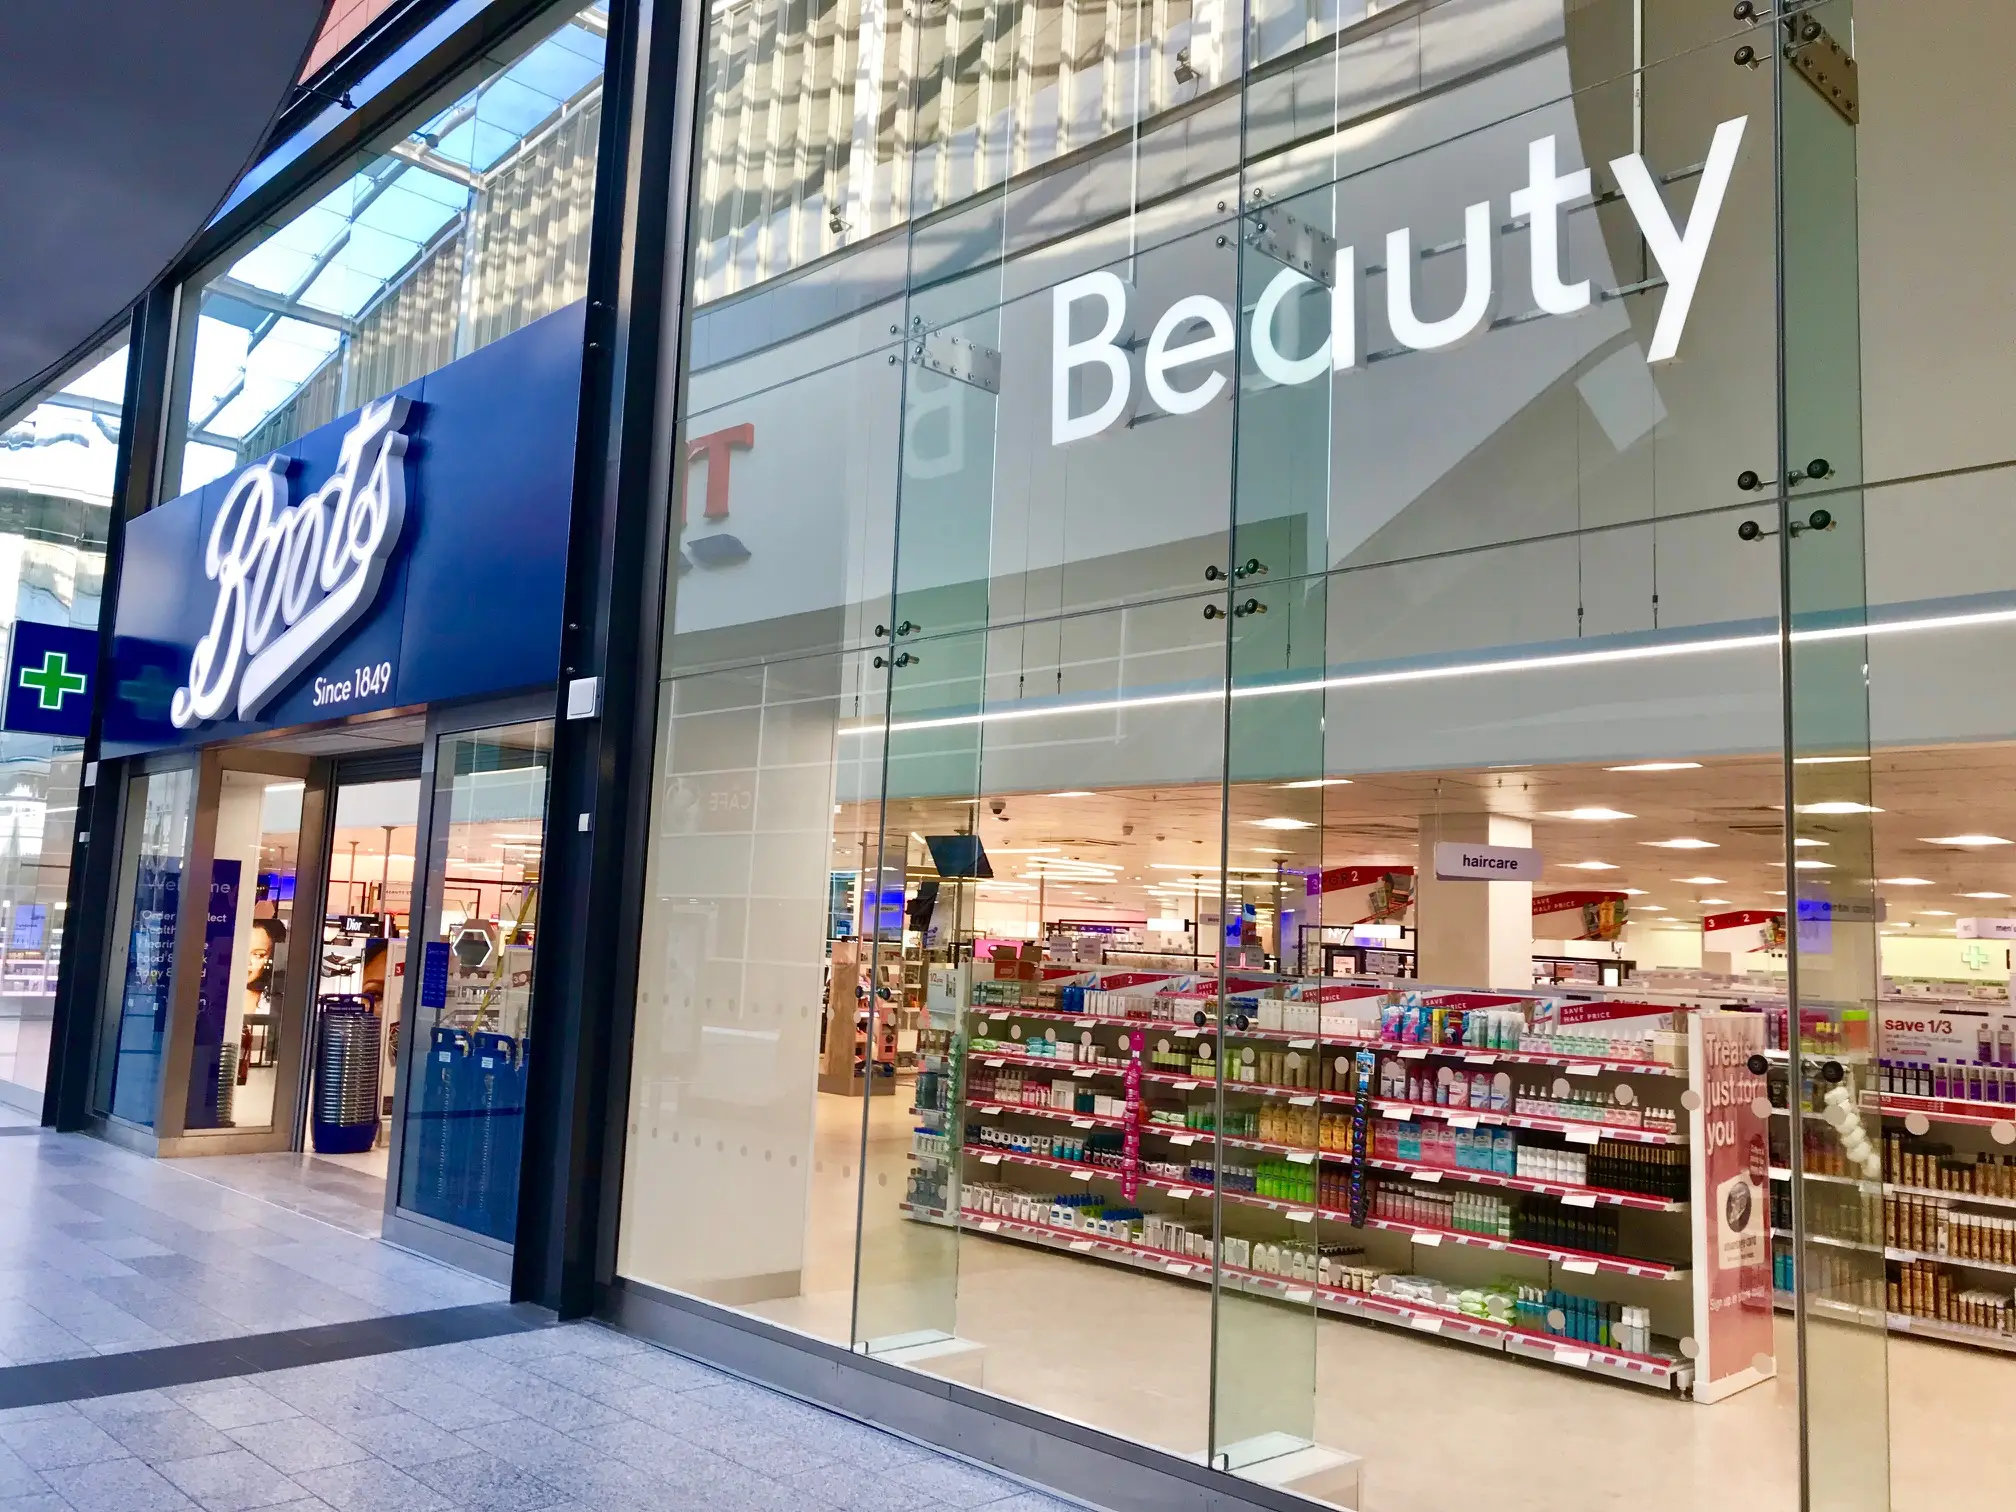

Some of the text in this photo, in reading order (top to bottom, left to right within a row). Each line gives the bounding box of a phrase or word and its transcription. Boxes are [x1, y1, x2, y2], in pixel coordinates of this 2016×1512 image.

[1050, 114, 1748, 446] Beauty
[171, 395, 405, 728] Boots
[312, 661, 392, 707] Since 1849
[1462, 854, 1519, 870] haircare
[1351, 870, 1359, 882] 2
[346, 917, 362, 931] Dior
[1708, 914, 1750, 928] 3 2
[395, 966, 401, 974] 3
[1102, 980, 1108, 989] 3
[1127, 975, 1133, 983] 2
[1198, 982, 1212, 990] SAVE
[1321, 994, 1341, 1002] PRICE
[1425, 998, 1443, 1006] SAVE
[1563, 1006, 1584, 1015] SAVE
[1563, 1011, 1612, 1023] HALF PRICE
[1884, 1019, 1953, 1035] save 1/3
[1705, 1073, 1736, 1115] just
[1706, 1120, 1735, 1156] you
